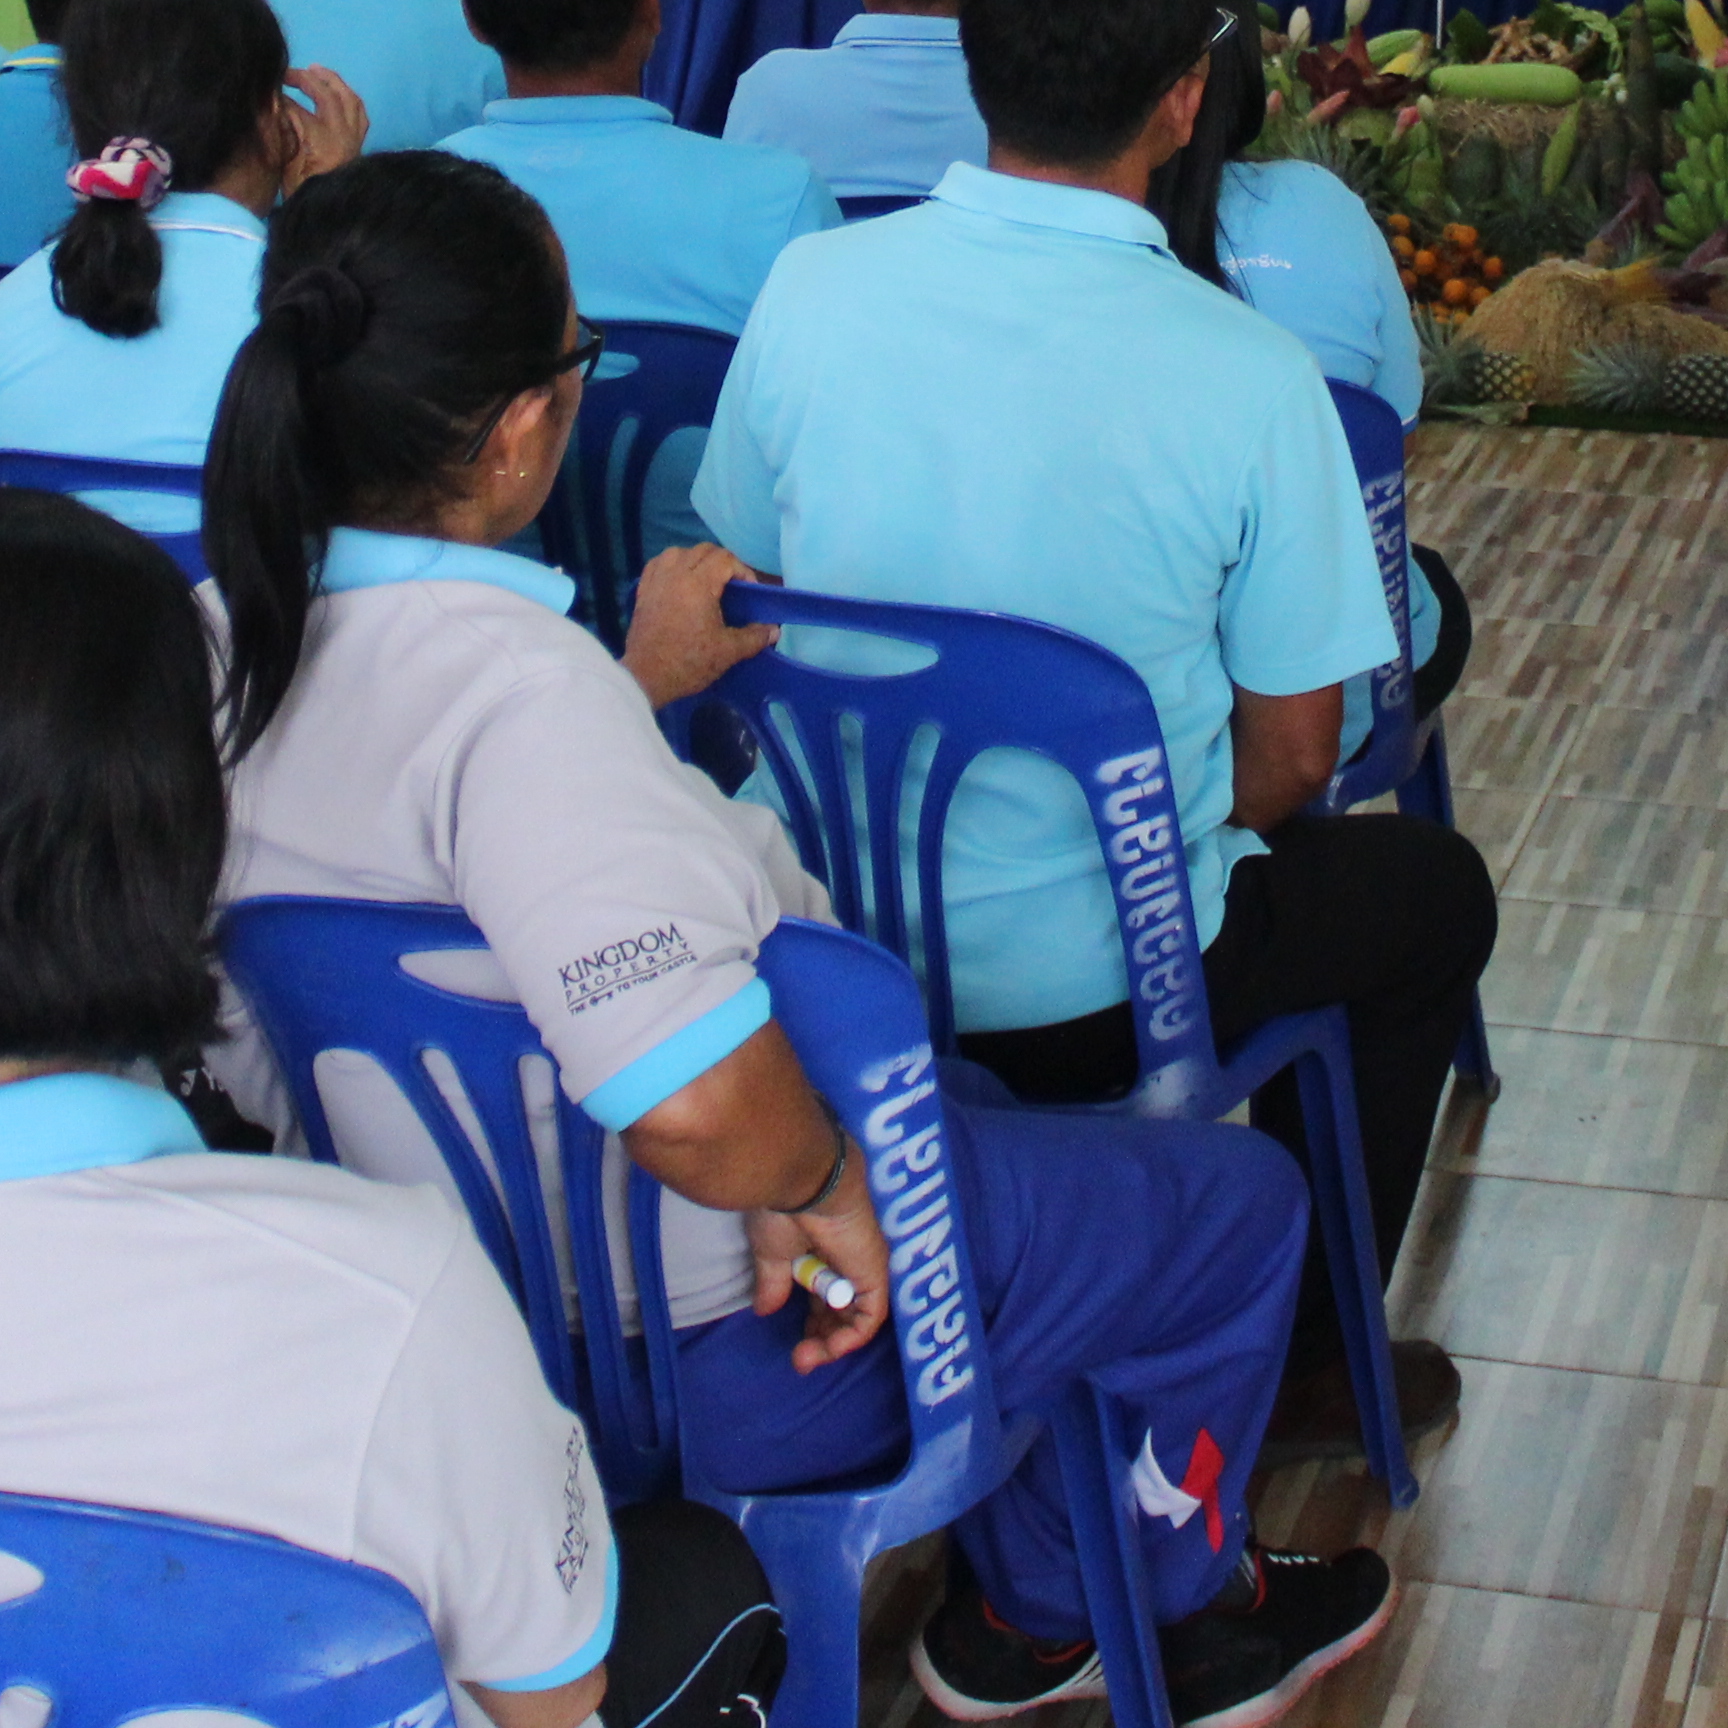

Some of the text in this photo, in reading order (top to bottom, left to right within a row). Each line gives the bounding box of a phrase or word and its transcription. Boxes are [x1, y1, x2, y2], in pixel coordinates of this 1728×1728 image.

[1095, 747, 1195, 1041] คลองกลาง
[558, 922, 684, 988] KINGDOM
[565, 942, 688, 1002] PROPERTY
[616, 981, 631, 992] TO
[860, 1042, 975, 1410] คลองกลาง
